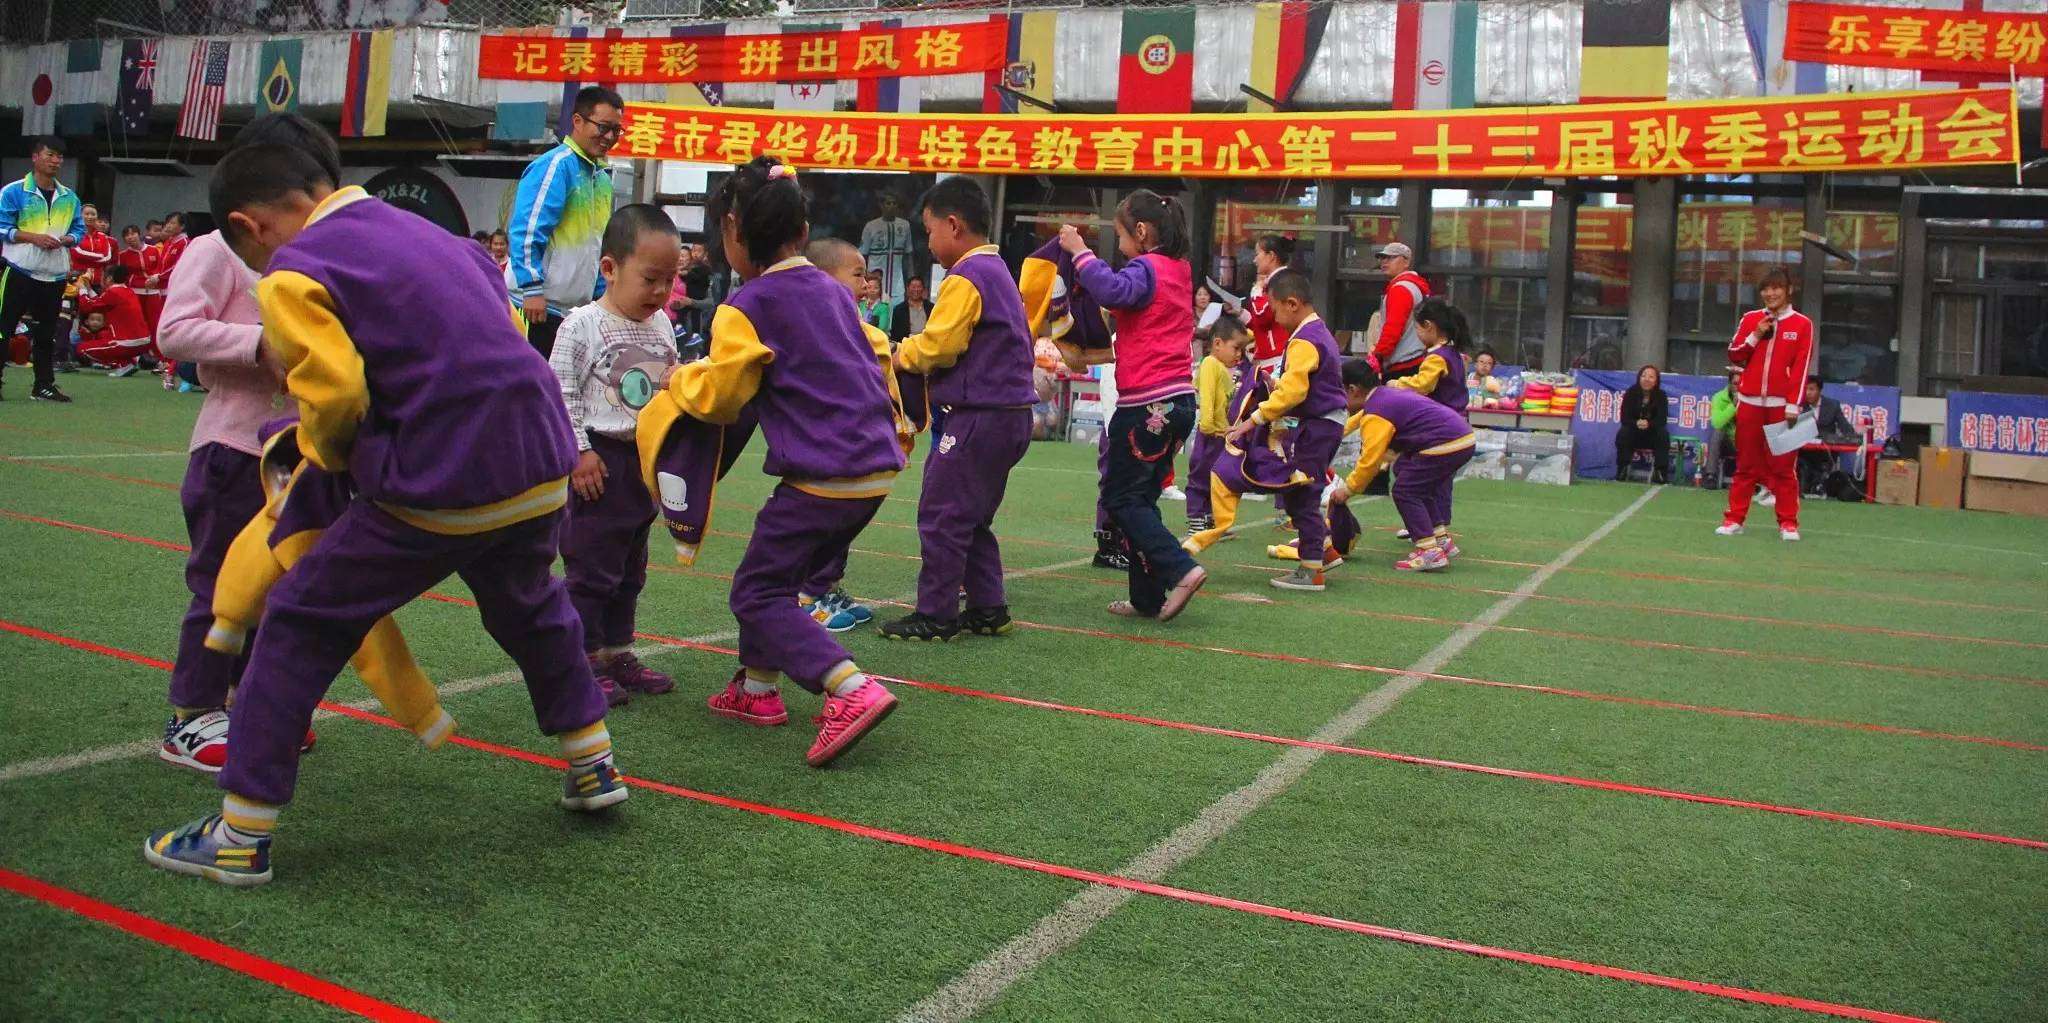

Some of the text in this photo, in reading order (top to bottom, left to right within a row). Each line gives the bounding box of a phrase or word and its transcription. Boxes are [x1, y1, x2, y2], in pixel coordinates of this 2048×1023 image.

[512, 29, 963, 77] 记录精彩 拼出风格
[1825, 14, 2047, 64] 乐享缤纷
[613, 97, 2007, 175] 春市君华幼儿特色教育中心第二十三届秋季运动会
